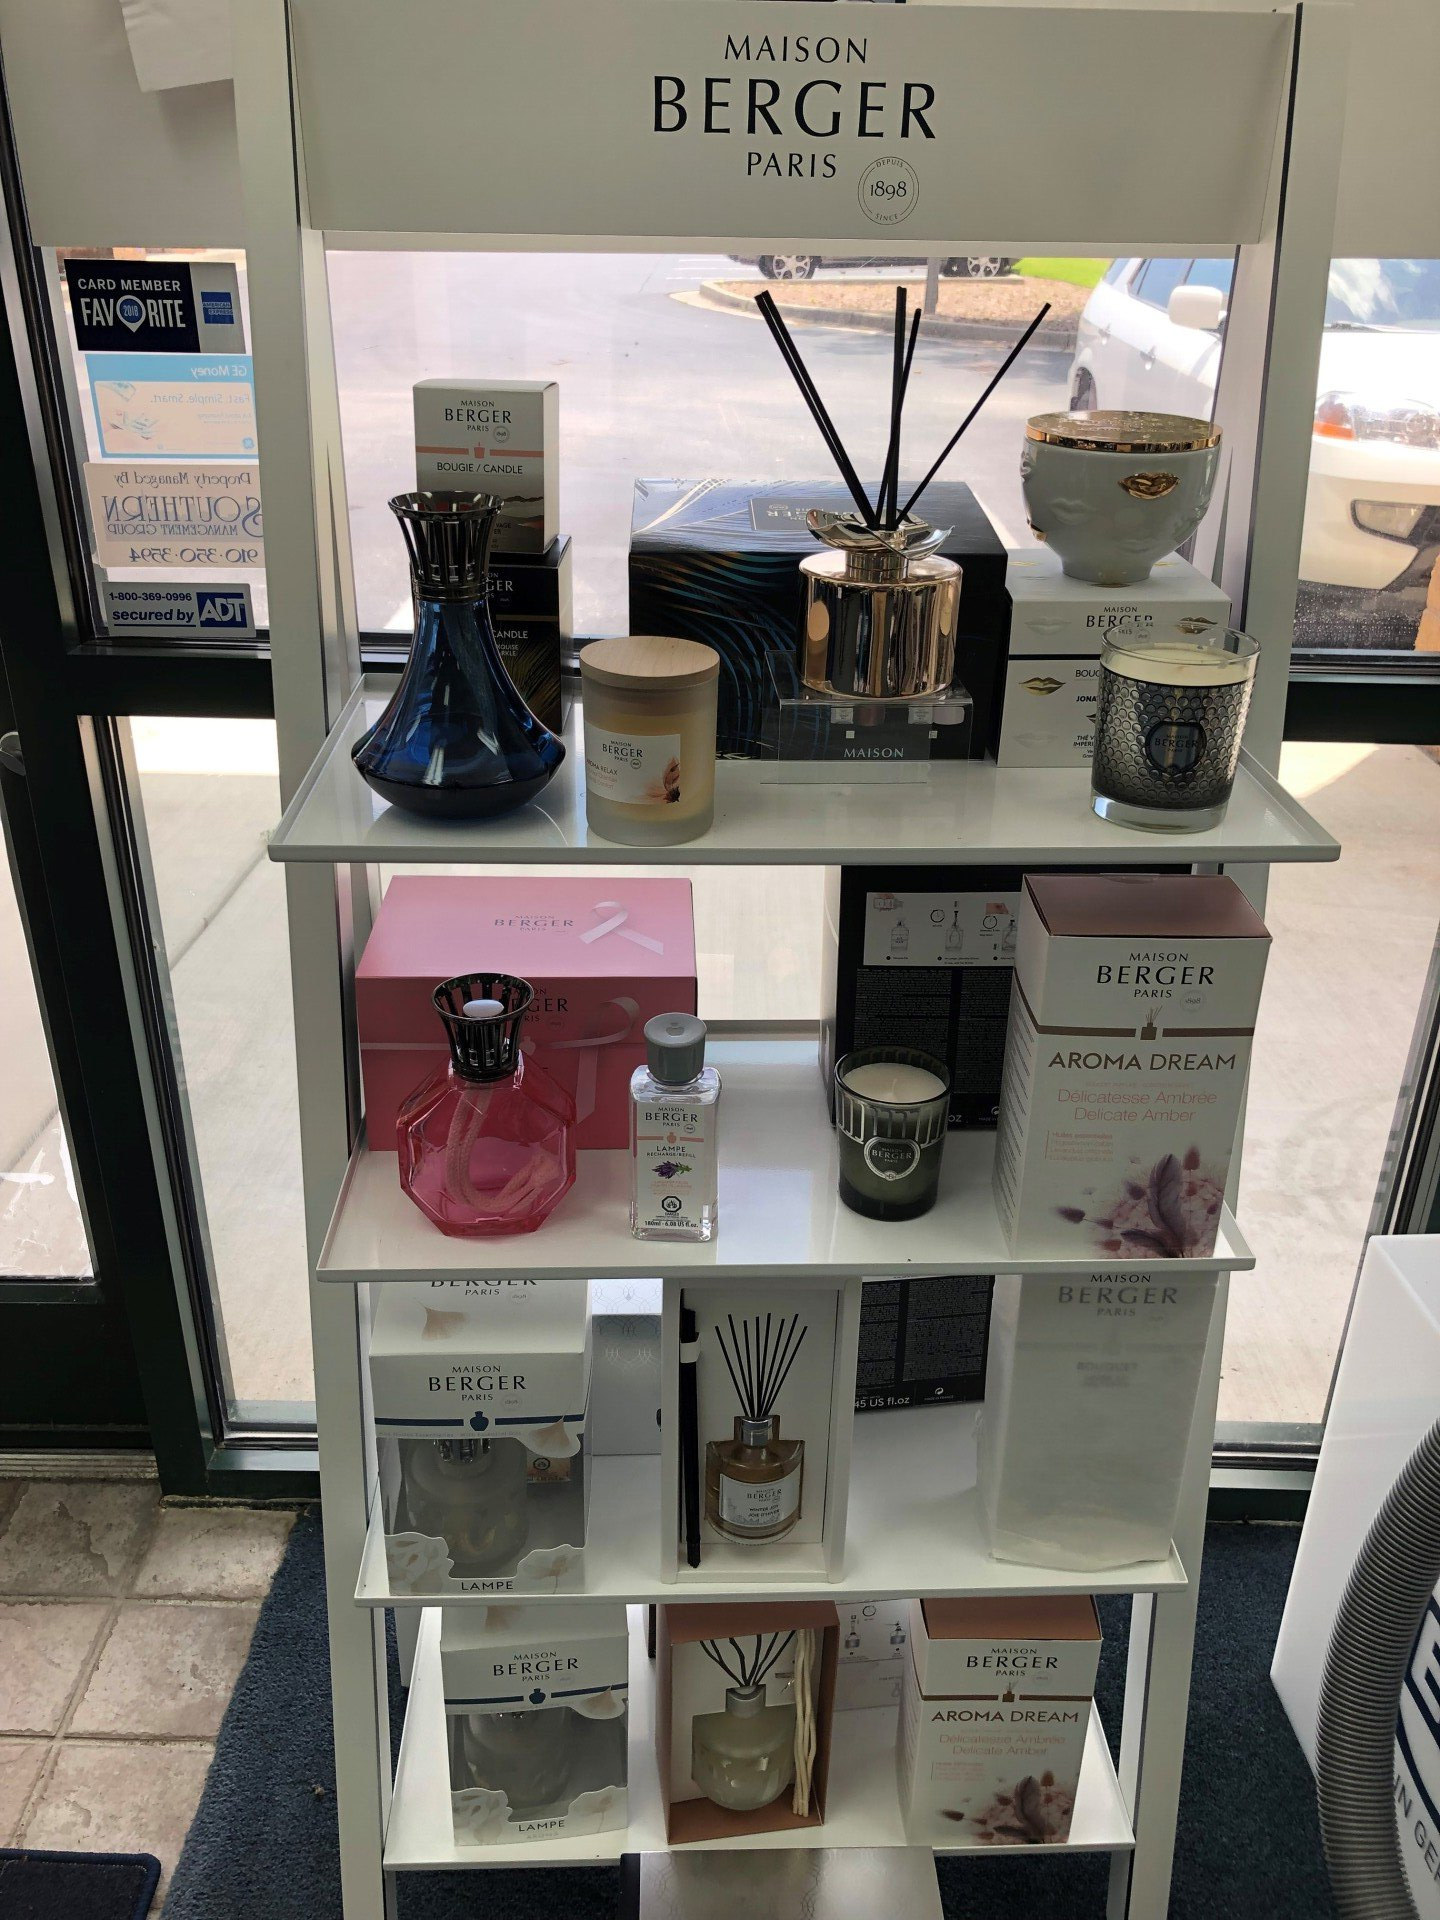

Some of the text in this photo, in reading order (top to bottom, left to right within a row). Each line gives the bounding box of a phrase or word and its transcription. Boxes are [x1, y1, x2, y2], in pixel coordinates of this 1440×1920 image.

[724, 34, 868, 64] MAISON
[652, 75, 937, 140] BERGER
[746, 151, 838, 180] PARIS
[875, 158, 905, 169] DEPUIS
[869, 180, 908, 201] 1898
[874, 212, 900, 222] SINCE
[77, 278, 181, 292] CARD MEMBER
[208, 308, 234, 316] EXPRESS
[460, 400, 495, 408] MAISON
[444, 408, 512, 424] BERGER
[436, 462, 474, 472] BOUGIE
[483, 464, 523, 475] CANDLE
[109, 592, 192, 601] 1-800-369-0996
[199, 597, 246, 622] ADT
[112, 608, 194, 623] secured by
[610, 740, 632, 748] MAISON
[1154, 737, 1198, 749] BERGER
[602, 744, 643, 758] BERGER
[843, 747, 905, 758] MAISON
[601, 764, 618, 776] RELAX
[493, 919, 574, 928] BERGER
[1128, 952, 1189, 962] MAISON
[1096, 965, 1215, 985] BERGER
[1133, 988, 1173, 998] PARIS
[1048, 1052, 1236, 1071] AROMA DREAM
[1057, 1088, 1218, 1105] Délicatesse Ambrée
[645, 1112, 698, 1122] BERGER
[1073, 1107, 1197, 1122] Delicate Amber
[871, 1149, 913, 1159] BERGER
[1090, 1274, 1152, 1283] MAISON
[465, 1288, 500, 1296] PARIS
[1058, 1286, 1178, 1304] BERGER
[1096, 1307, 1137, 1317] PARIS
[451, 1365, 502, 1373] MAISON
[428, 1375, 527, 1392] BERGER
[460, 1393, 494, 1401] PARIS
[869, 1398, 885, 1407] US
[887, 1396, 910, 1406] fl.oz
[747, 1488, 782, 1499] BERGER
[460, 1581, 514, 1591] LAMPE
[513, 1651, 558, 1661] MAISON
[493, 1657, 579, 1676] BERGER
[966, 1655, 1059, 1669] BERGER
[522, 1674, 550, 1682] PARIS
[931, 1710, 1079, 1722] AROMA DREAM
[518, 1819, 566, 1832] LAMPE
